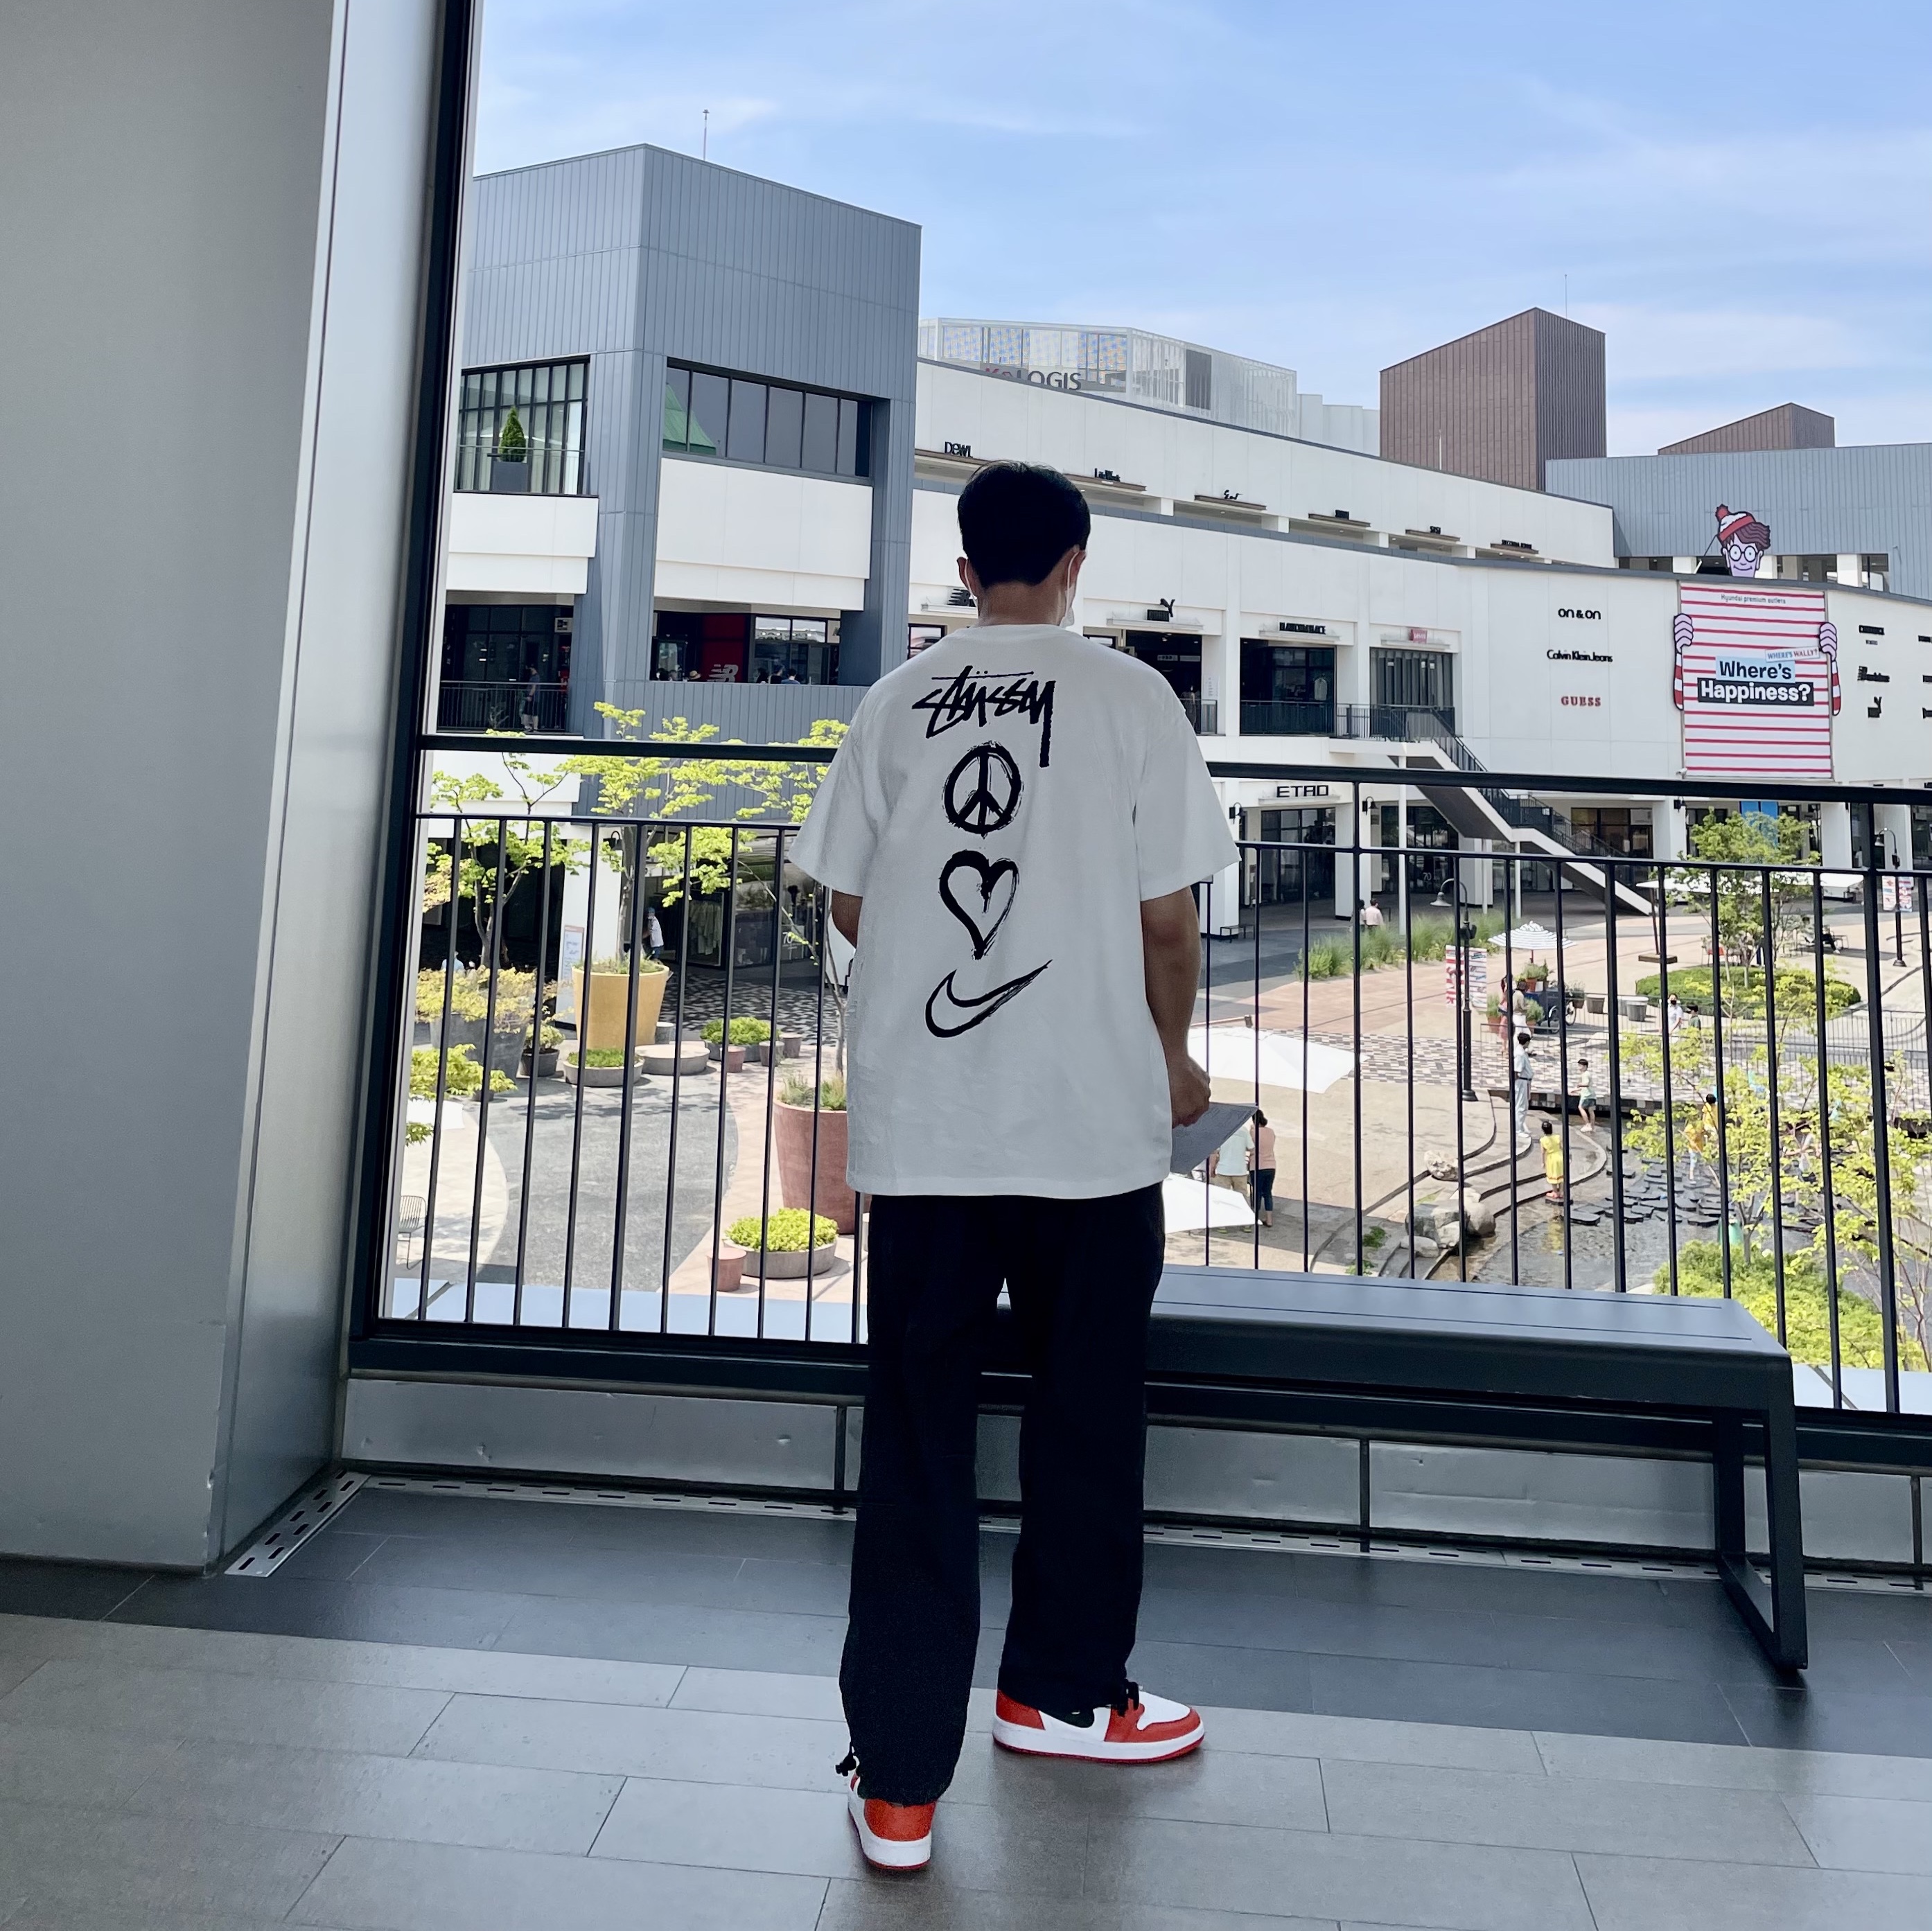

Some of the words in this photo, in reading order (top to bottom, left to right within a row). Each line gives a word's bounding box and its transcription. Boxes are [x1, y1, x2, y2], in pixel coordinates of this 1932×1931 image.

[1547, 649, 1571, 660] Calvin
[1719, 660, 1791, 680] Where's
[1701, 680, 1811, 703] Happiness?
[1561, 696, 1601, 707] GUESS
